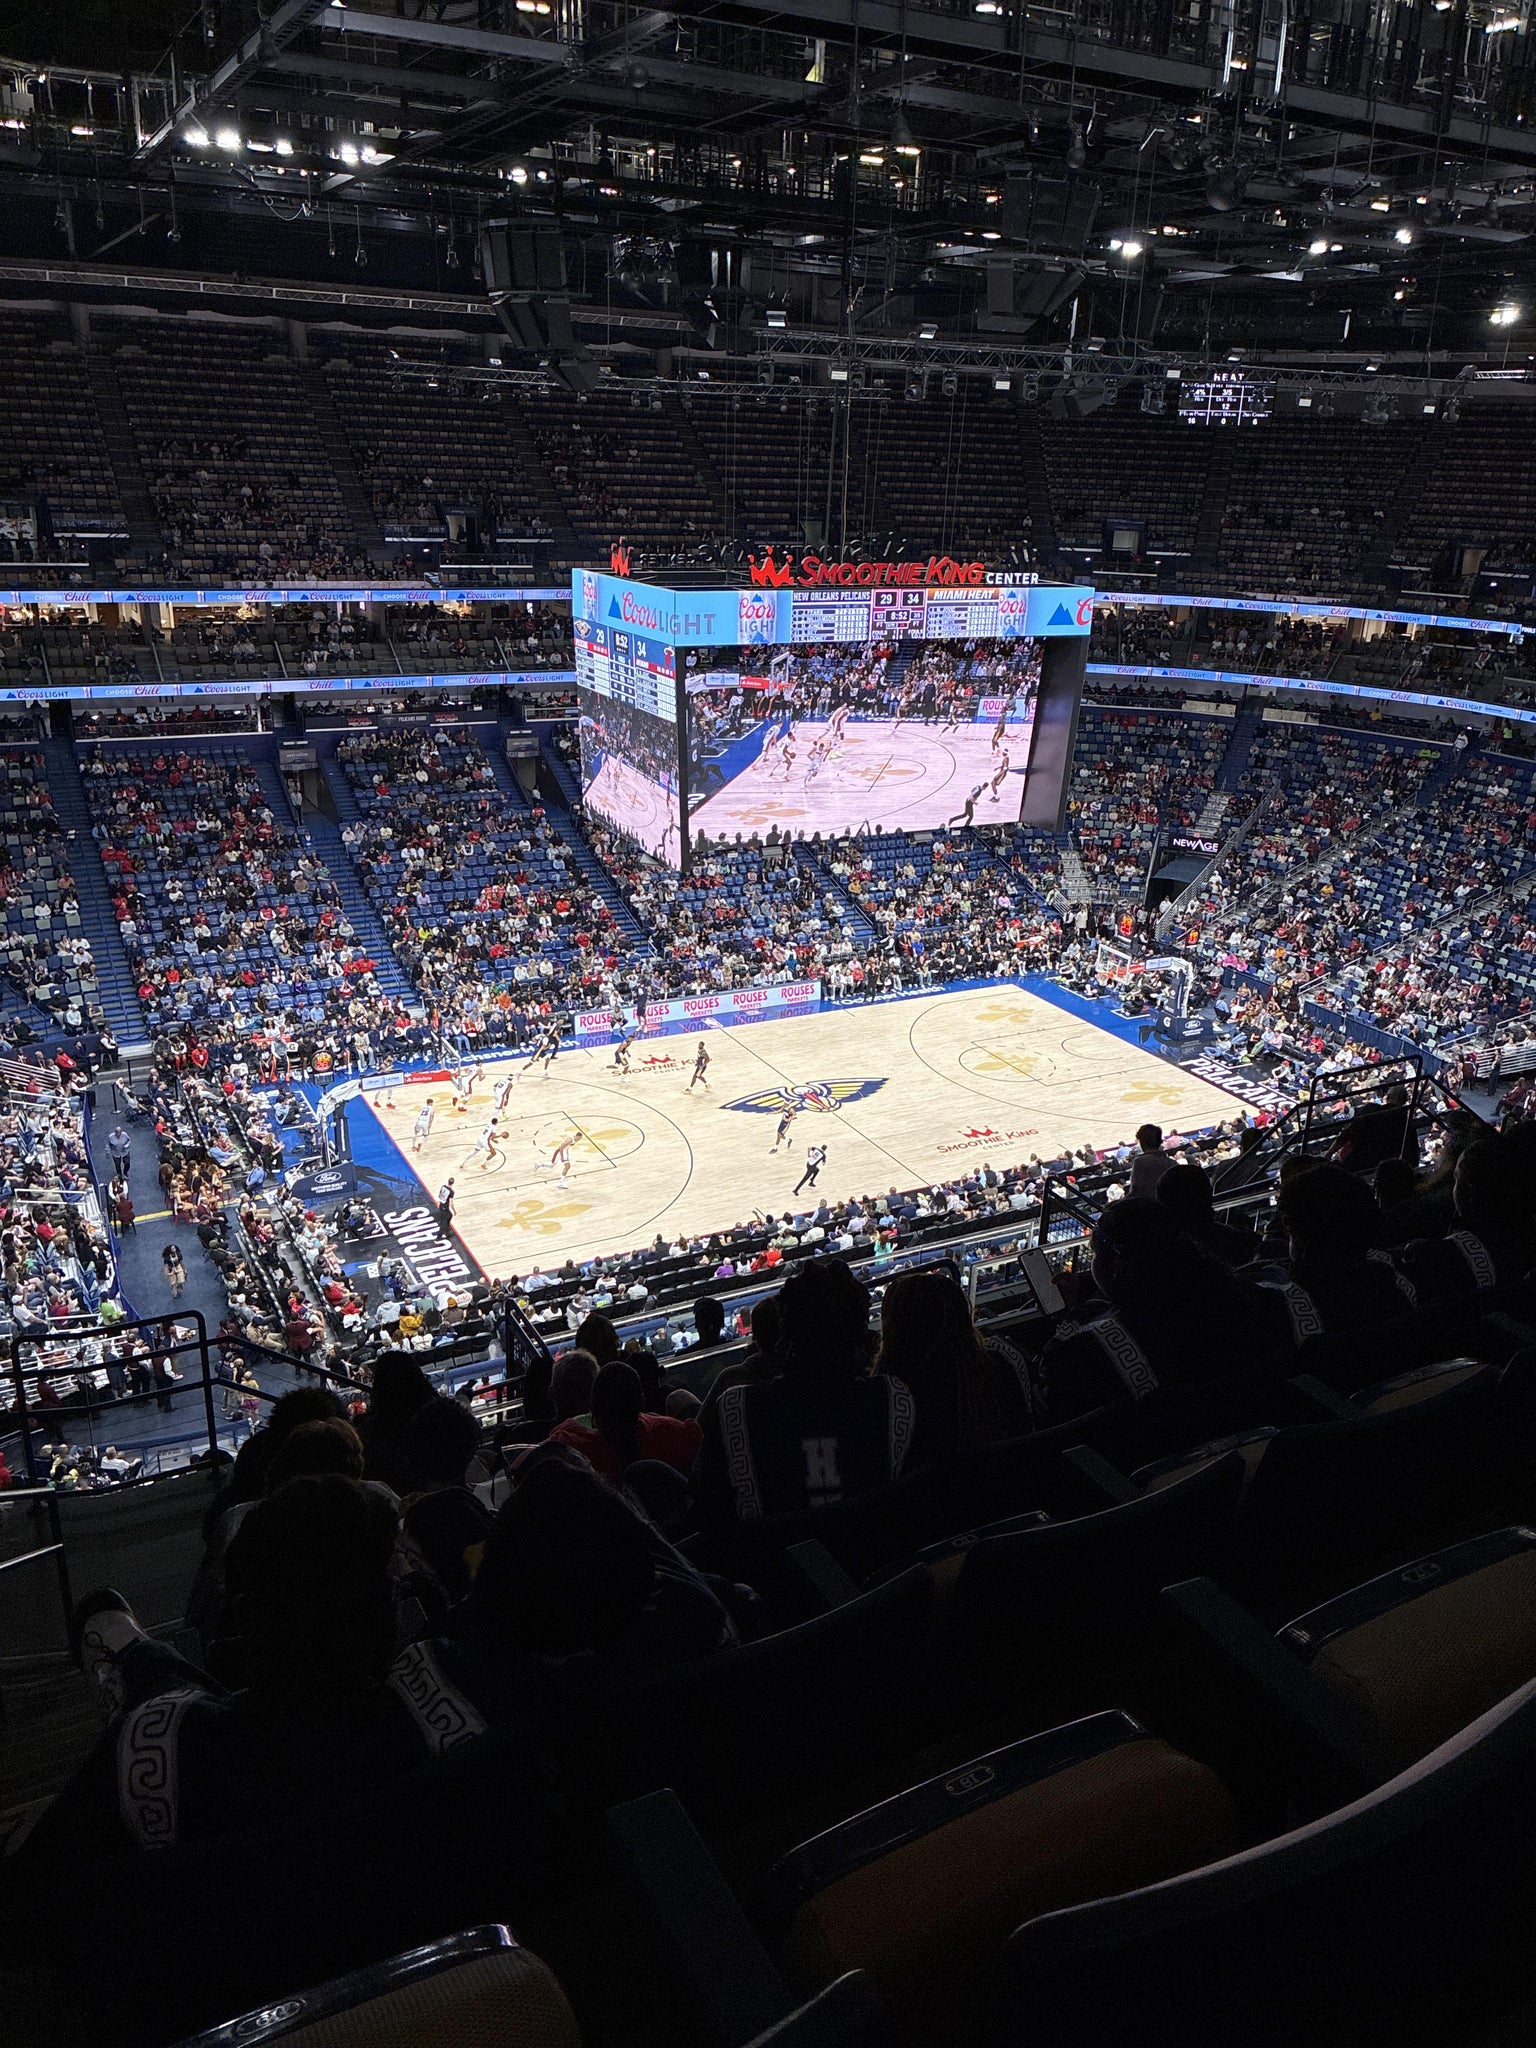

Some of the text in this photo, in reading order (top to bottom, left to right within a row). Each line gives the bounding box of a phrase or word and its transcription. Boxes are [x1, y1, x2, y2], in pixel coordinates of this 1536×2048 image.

[1214, 373, 1244, 382] HEAT
[798, 556, 924, 586] SMOOTHIE
[986, 572, 1039, 584] CENTER
[64, 591, 91, 602] Chill
[136, 592, 162, 602] Coors
[244, 591, 270, 601] Chill
[309, 592, 333, 601] Coors
[407, 591, 430, 600] Chill
[466, 591, 487, 599] Coors
[793, 591, 870, 601] NEW ORLEANS PELICANS
[880, 593, 920, 604] 29 34
[934, 590, 995, 600] MIAMI HEAT
[622, 592, 716, 635] Coors LIGHT
[1330, 607, 1351, 615] Chill
[891, 612, 908, 620] 8:52
[1383, 612, 1403, 620] Coors
[1470, 620, 1492, 629] Chill
[596, 629, 605, 644] 29
[615, 633, 628, 648] 8:52
[637, 641, 646, 657] 34
[468, 675, 489, 684] Chill
[525, 674, 545, 682] Coors
[1252, 676, 1273, 685] Chill
[309, 680, 334, 689] Chill
[372, 679, 395, 688] Coors
[134, 686, 160, 695] Chill
[204, 684, 229, 694] Coors
[17, 690, 44, 699] Coors
[1390, 691, 1411, 700] Chill
[1446, 699, 1465, 708] Coors
[781, 984, 815, 998] ROUSES
[733, 991, 768, 1005] ROUSES
[684, 998, 720, 1012] ROUSES
[580, 1013, 613, 1027] ROUSE
[1164, 1016, 1171, 1027] G
[937, 1136, 1004, 1154] SMOOTHIE
[982, 1141, 1015, 1150] CENTER
[320, 1173, 337, 1182] Ford
